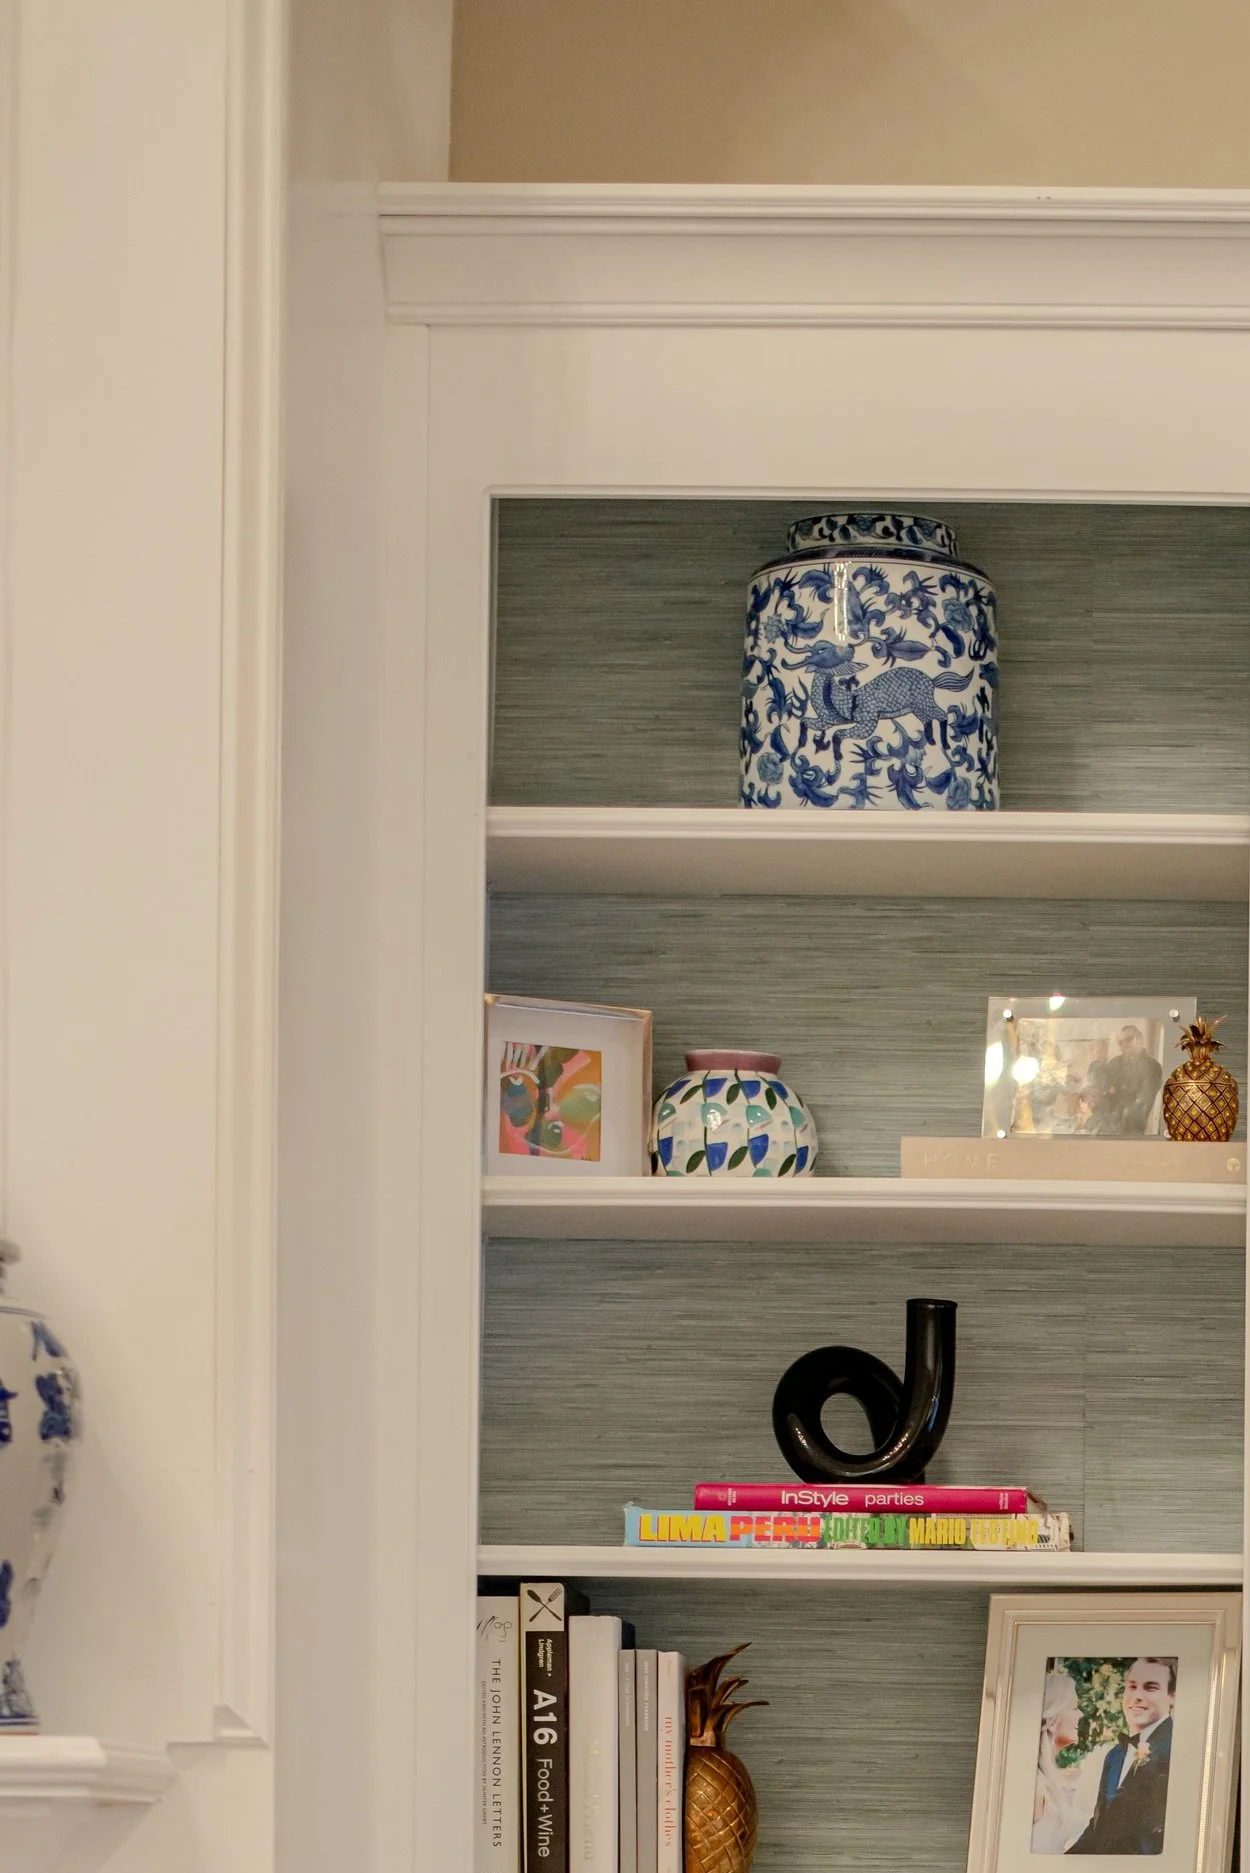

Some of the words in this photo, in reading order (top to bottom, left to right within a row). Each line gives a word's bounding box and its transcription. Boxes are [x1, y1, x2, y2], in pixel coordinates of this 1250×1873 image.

[782, 1490, 849, 1507] InStyle
[865, 1493, 924, 1506] parties
[640, 1514, 727, 1543] LIMA
[730, 1516, 821, 1542] PERU
[824, 1515, 881, 1544] EDITED
[883, 1516, 908, 1544] BY
[909, 1518, 967, 1545] MARIO
[970, 1518, 1039, 1545] TESTINO
[492, 1659, 501, 1683] THE
[490, 1689, 501, 1725] JOHN
[533, 1689, 558, 1745] A16
[664, 1717, 673, 1735] my
[492, 1731, 501, 1787] LENNON
[664, 1740, 678, 1797] mother's
[492, 1794, 502, 1847] LETTERS
[664, 1800, 677, 1847] clothes
